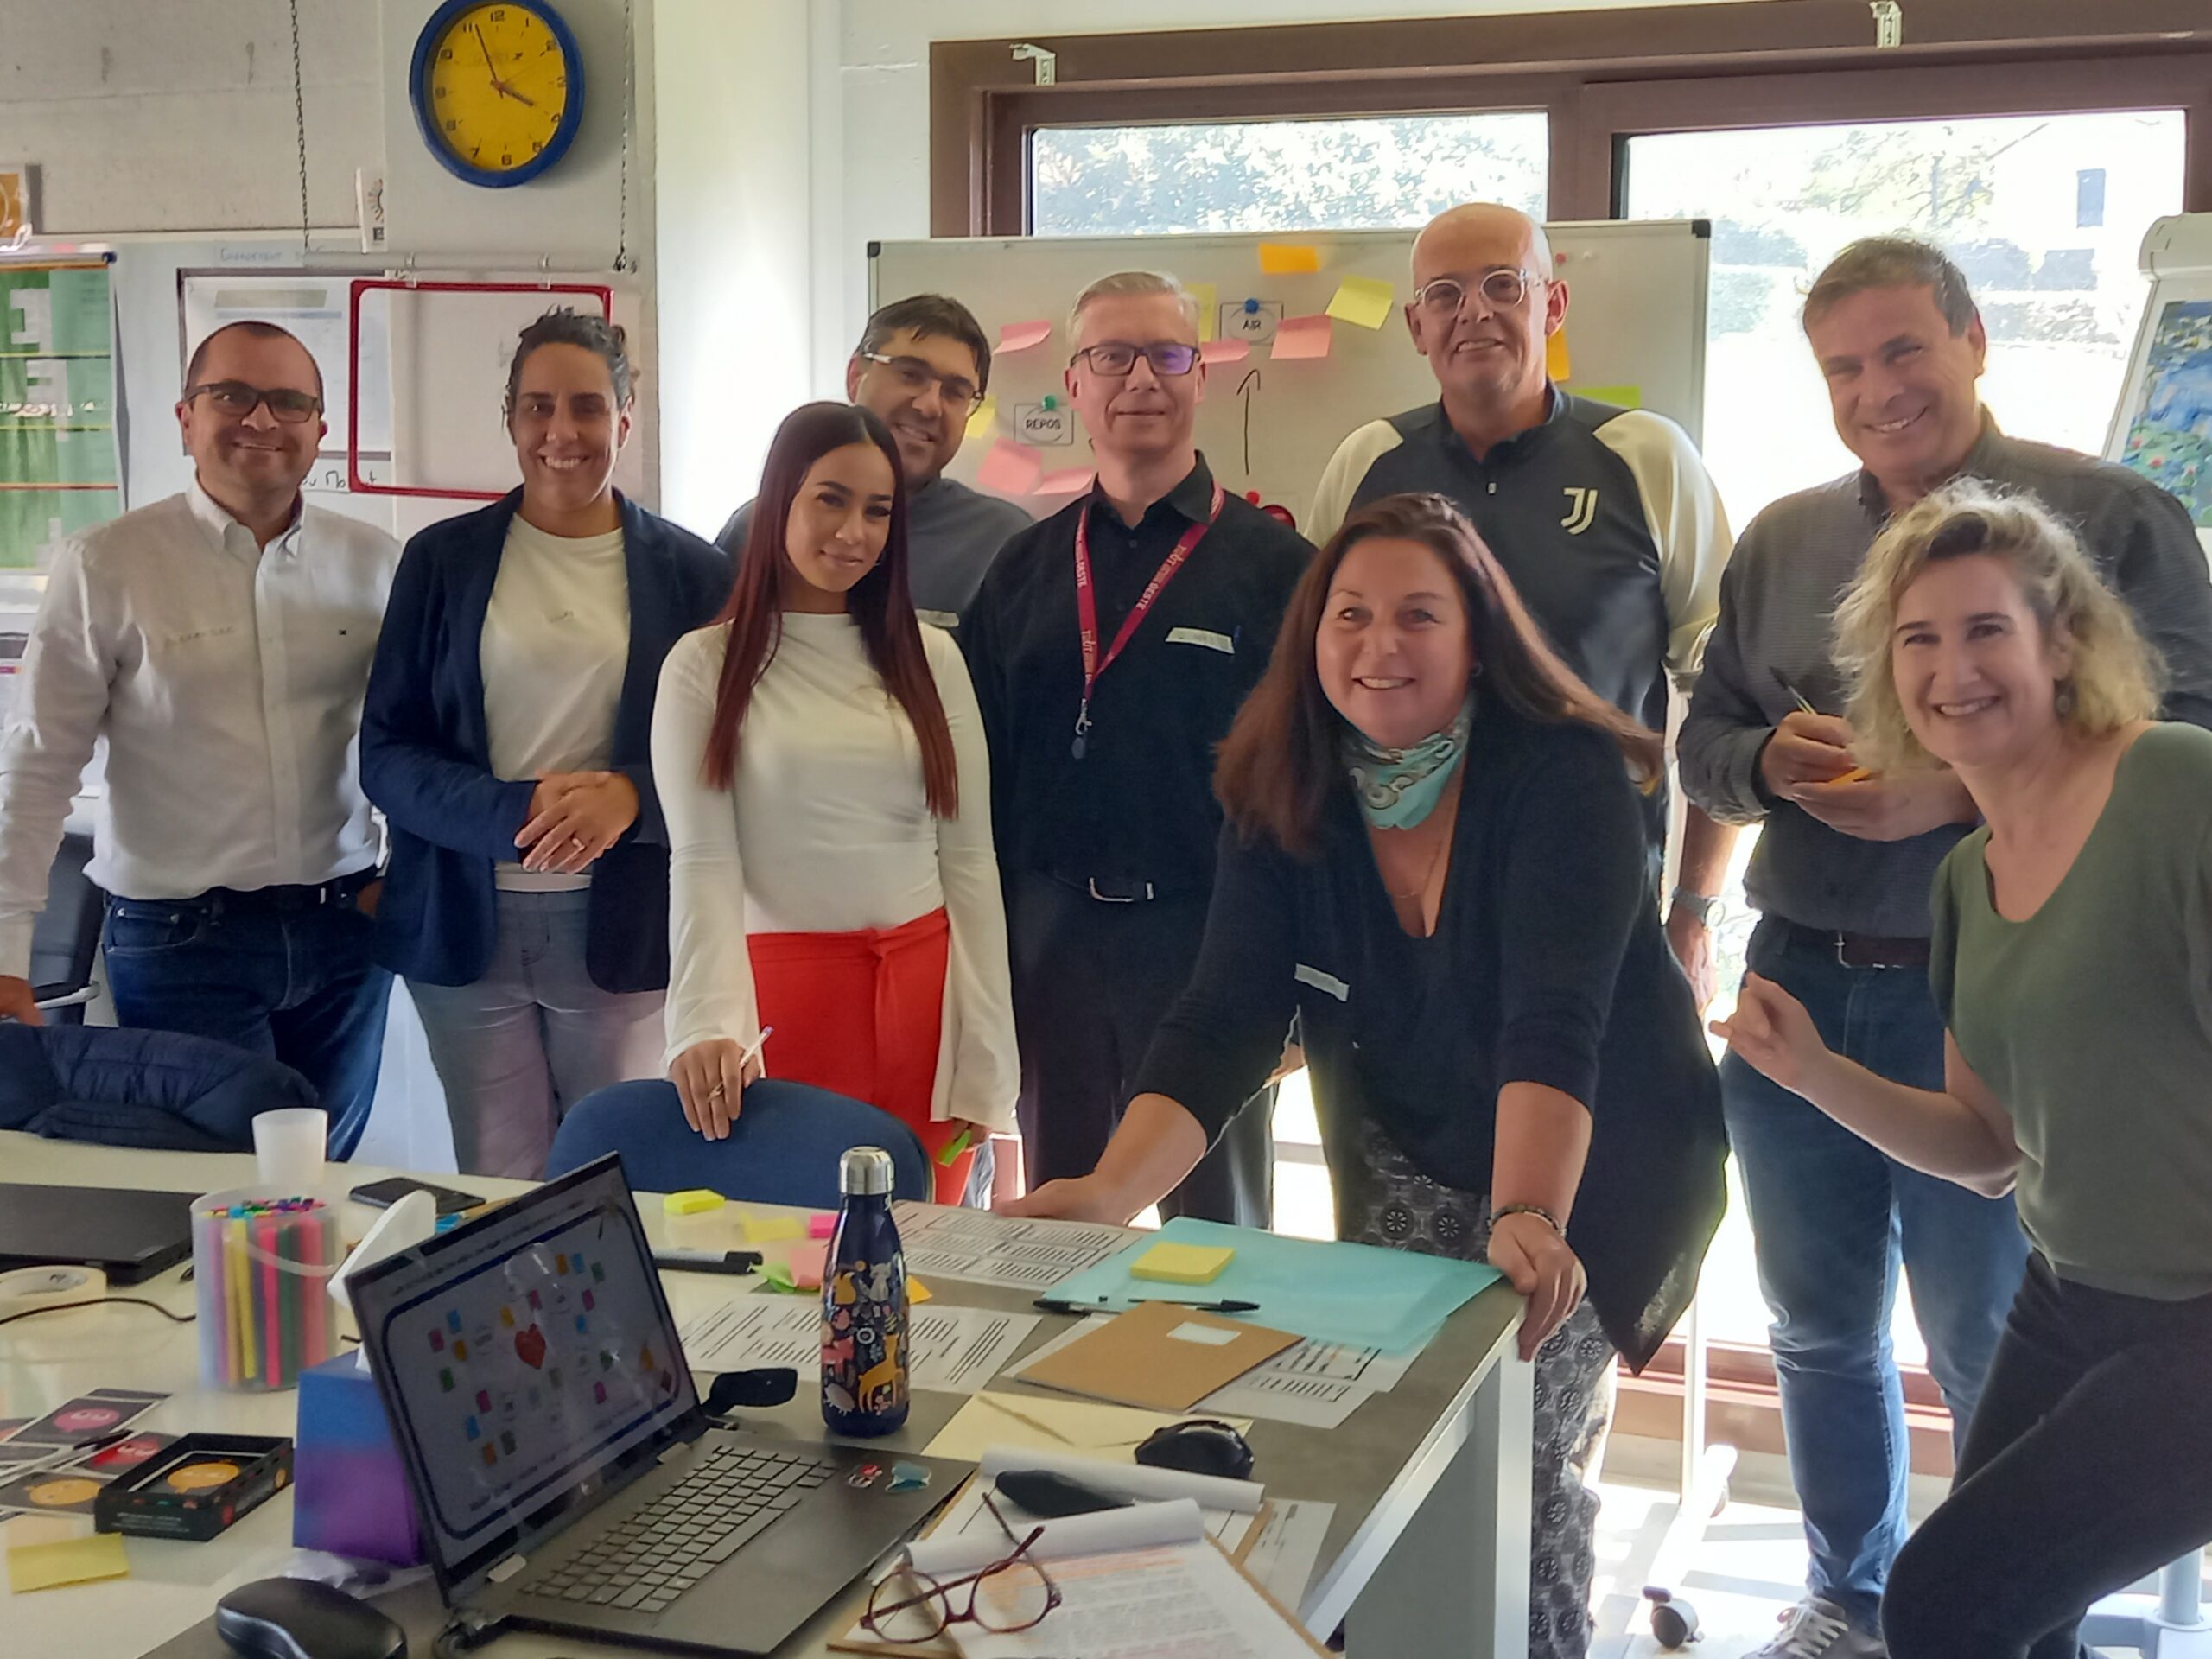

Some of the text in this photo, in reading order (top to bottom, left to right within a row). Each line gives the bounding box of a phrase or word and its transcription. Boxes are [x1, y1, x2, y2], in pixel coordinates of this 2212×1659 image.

[490, 10, 505, 22] 12
[462, 22, 473, 34] 11
[501, 154, 512, 166] 6
[1242, 319, 1262, 331] AIR
[1025, 418, 1062, 431] REPOS
